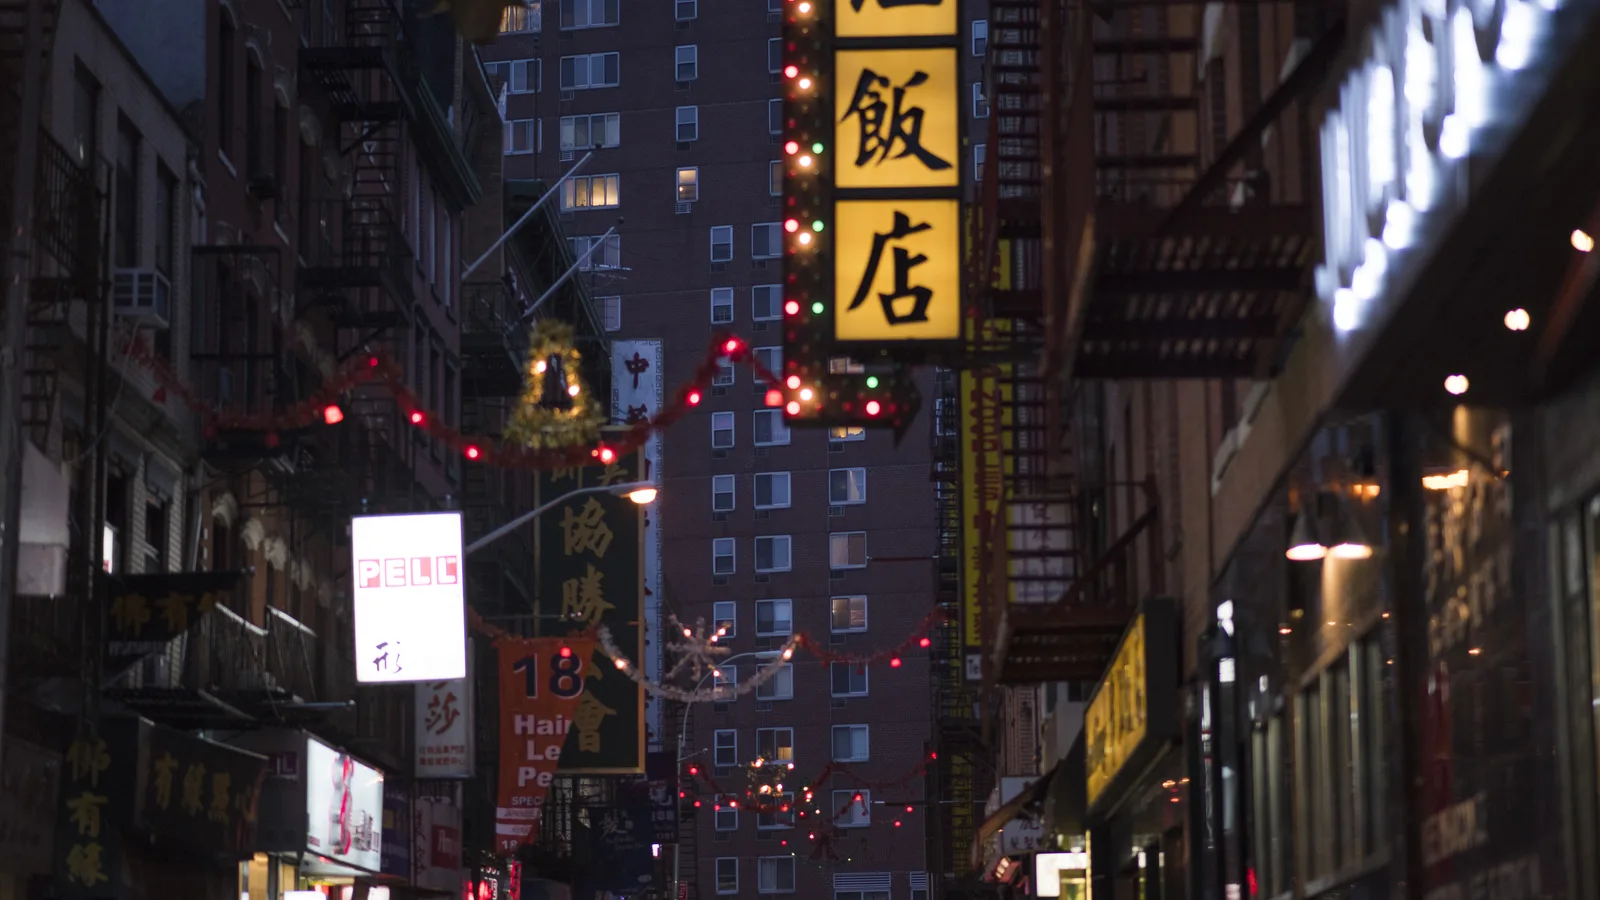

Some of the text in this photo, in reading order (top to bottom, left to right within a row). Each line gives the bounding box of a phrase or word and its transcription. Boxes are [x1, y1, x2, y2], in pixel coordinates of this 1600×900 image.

[840, 0, 953, 327] 飯店
[358, 555, 458, 588] PELL
[558, 495, 618, 753] 協勝會
[513, 652, 584, 700] 18
